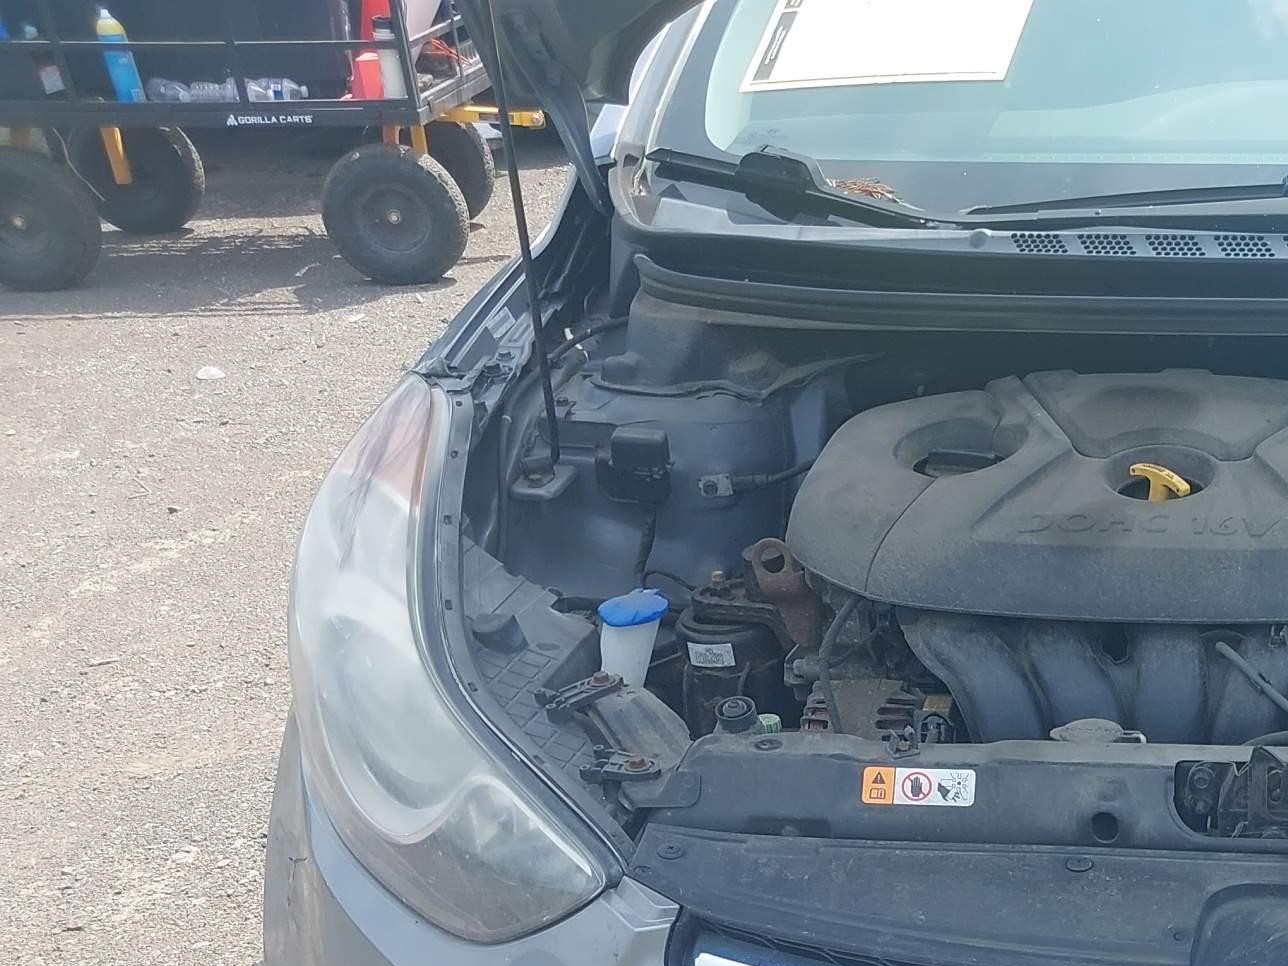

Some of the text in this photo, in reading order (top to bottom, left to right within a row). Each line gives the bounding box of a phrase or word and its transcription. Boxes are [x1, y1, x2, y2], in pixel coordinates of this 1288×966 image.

[237, 115, 313, 125] GORILLA CARTS
[1191, 515, 1281, 538] 16V
